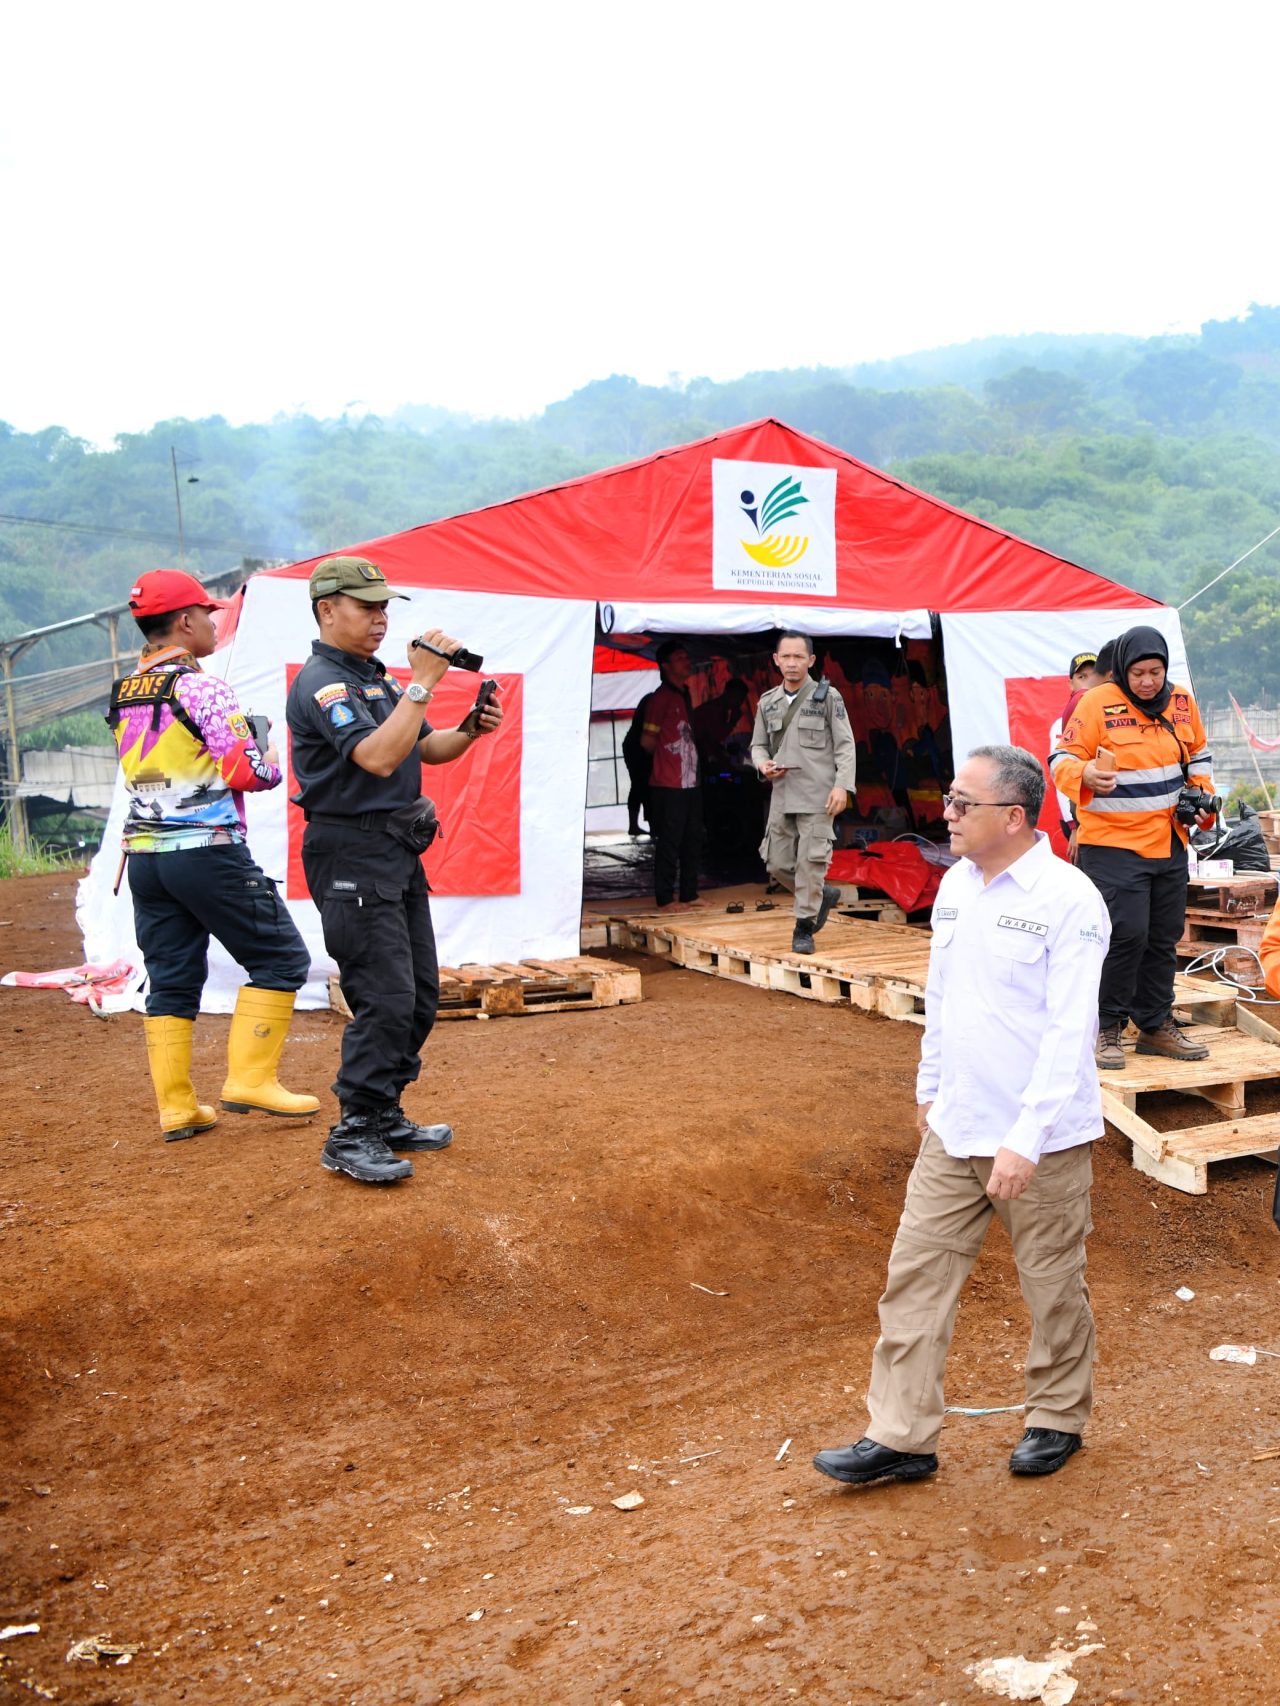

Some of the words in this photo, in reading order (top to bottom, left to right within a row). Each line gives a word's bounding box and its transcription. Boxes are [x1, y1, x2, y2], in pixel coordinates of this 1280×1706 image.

[731, 569, 792, 580] KEMENTERIAN
[794, 572, 823, 581] SOSIAL
[737, 578, 775, 587] REPUBLIK
[777, 580, 817, 589] INDONESIA
[1074, 654, 1098, 666] TAGAN
[1111, 719, 1132, 727] VIVI
[1004, 919, 1042, 932] WABUP
